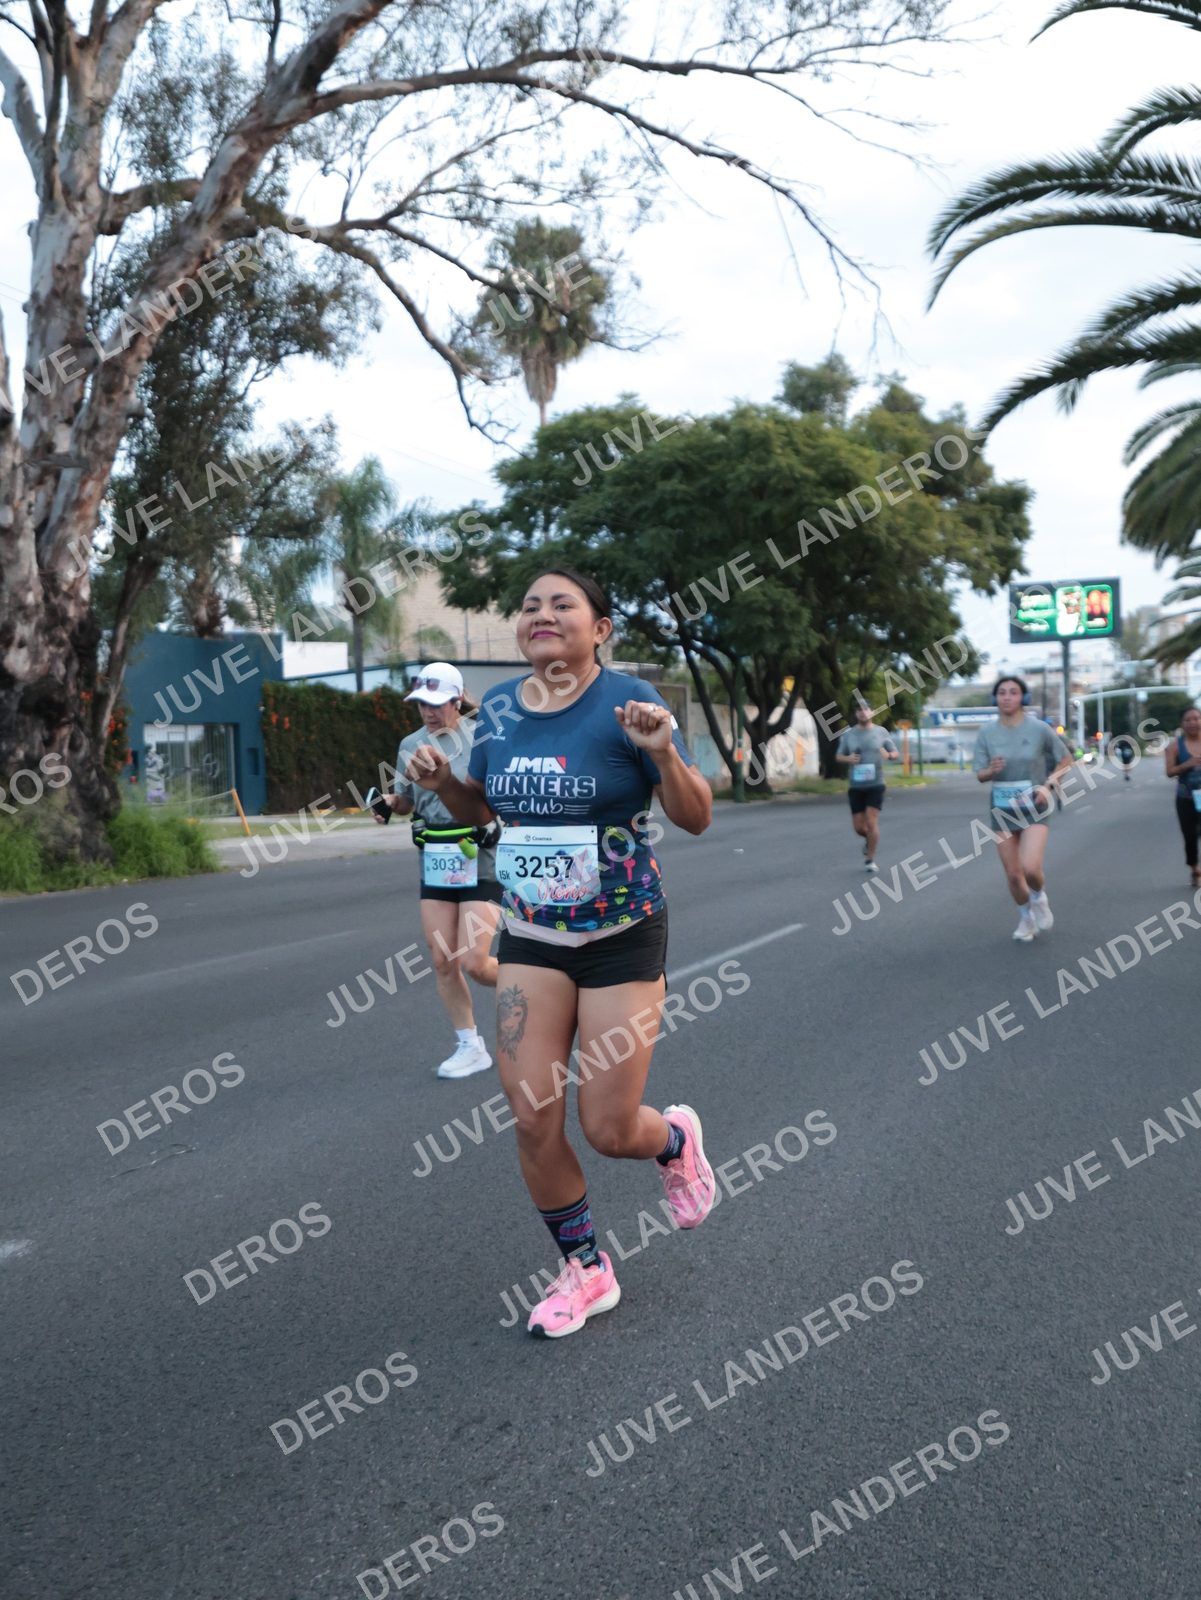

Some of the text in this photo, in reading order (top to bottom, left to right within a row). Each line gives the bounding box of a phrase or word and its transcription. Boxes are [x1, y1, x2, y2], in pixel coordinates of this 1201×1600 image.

[504, 756, 567, 774] JMA
[486, 775, 596, 798] RUNNERS
[518, 797, 564, 815] club
[431, 858, 465, 871] 3031
[514, 856, 574, 878] 3257
